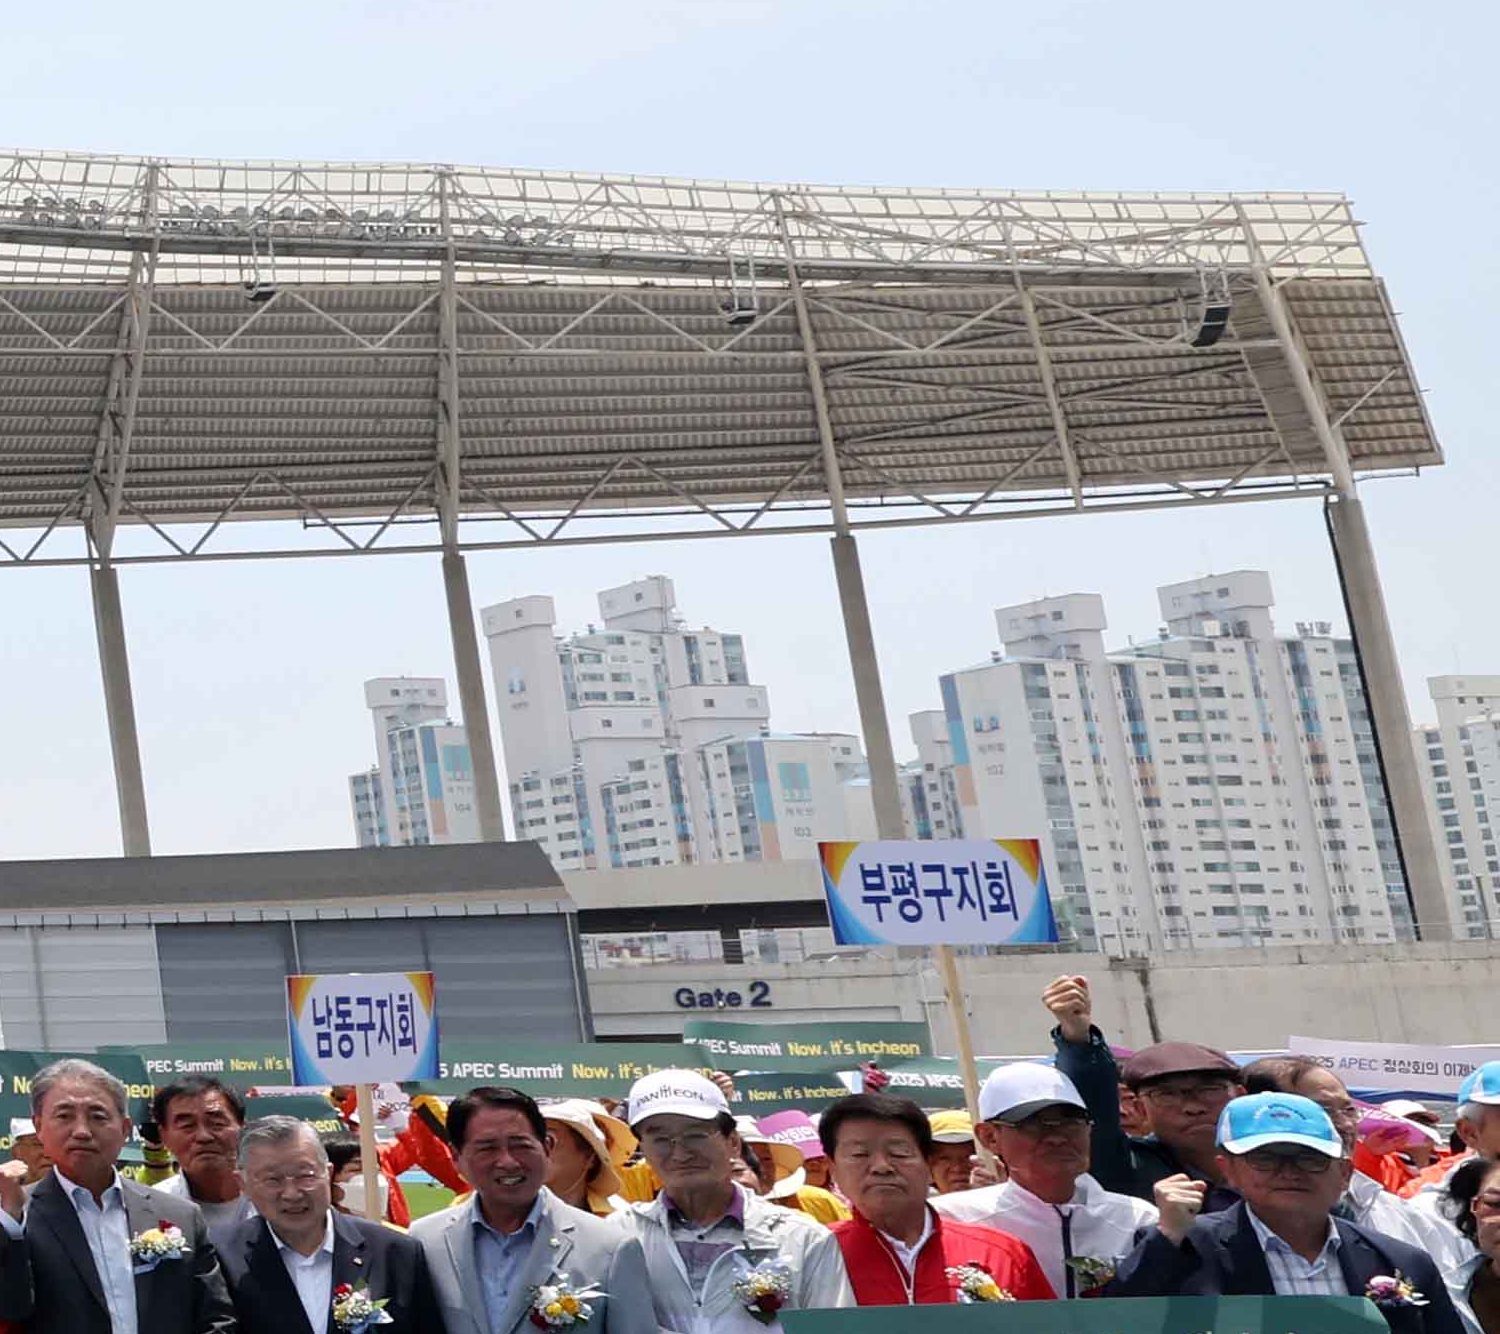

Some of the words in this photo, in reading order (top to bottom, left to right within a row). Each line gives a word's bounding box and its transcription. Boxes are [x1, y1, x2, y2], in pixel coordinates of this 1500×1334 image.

[860, 860, 1018, 924] 부평구지회
[675, 987, 742, 1010] Gate
[749, 981, 772, 1008] 2
[312, 992, 417, 1059] 남동구지회
[729, 1040, 782, 1056] Summit
[857, 1039, 921, 1056] Incheon
[174, 1058, 223, 1072] Summit
[452, 1064, 494, 1078] APEC
[498, 1063, 563, 1079] Summit
[618, 1062, 642, 1079] it's
[1339, 1057, 1379, 1071] APEC
[1383, 1058, 1438, 1076] 정상회의
